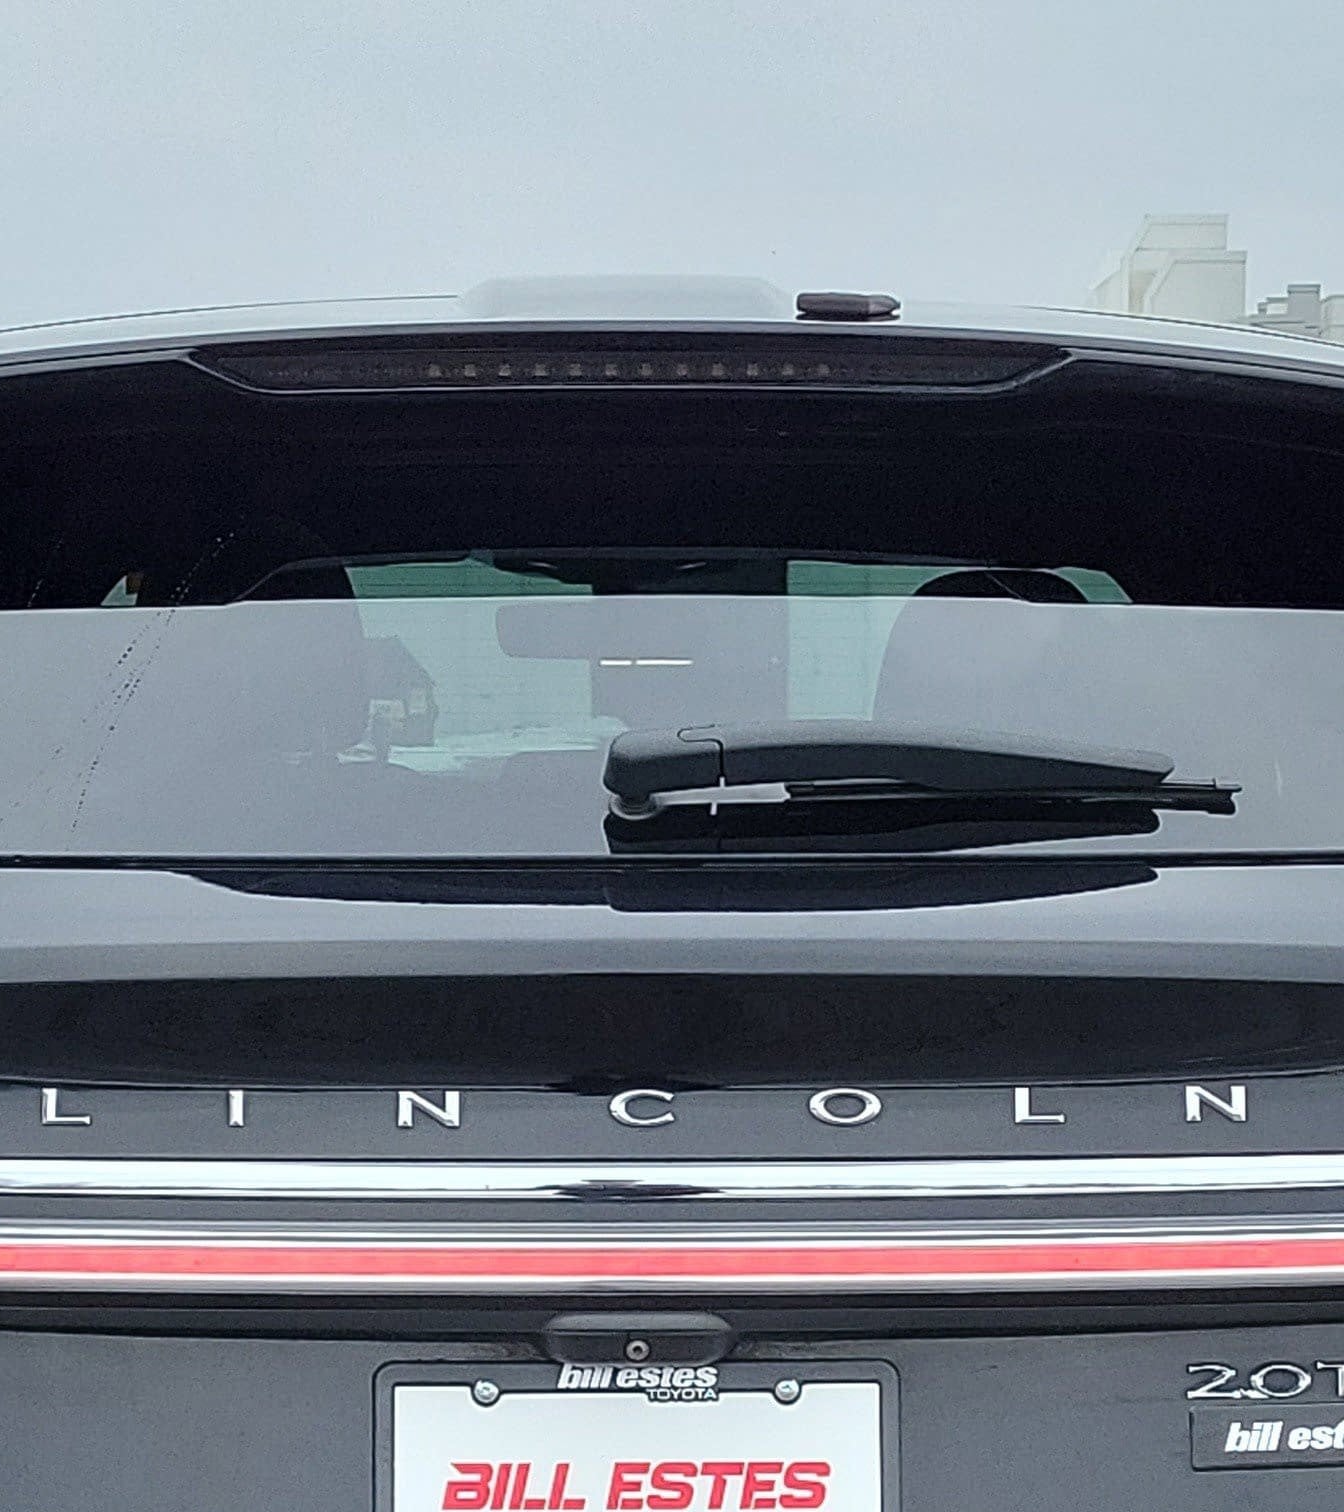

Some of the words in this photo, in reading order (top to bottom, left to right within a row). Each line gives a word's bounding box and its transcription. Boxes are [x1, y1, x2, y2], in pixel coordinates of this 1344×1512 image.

[41, 1085, 1248, 1128] LINCOLN
[557, 1364, 614, 1389] bill
[615, 1366, 719, 1389] estes
[646, 1388, 718, 1400] TOYOTA
[1224, 1420, 1284, 1453] bill
[441, 1461, 587, 1511] BILL
[606, 1461, 832, 1511] ESTES
